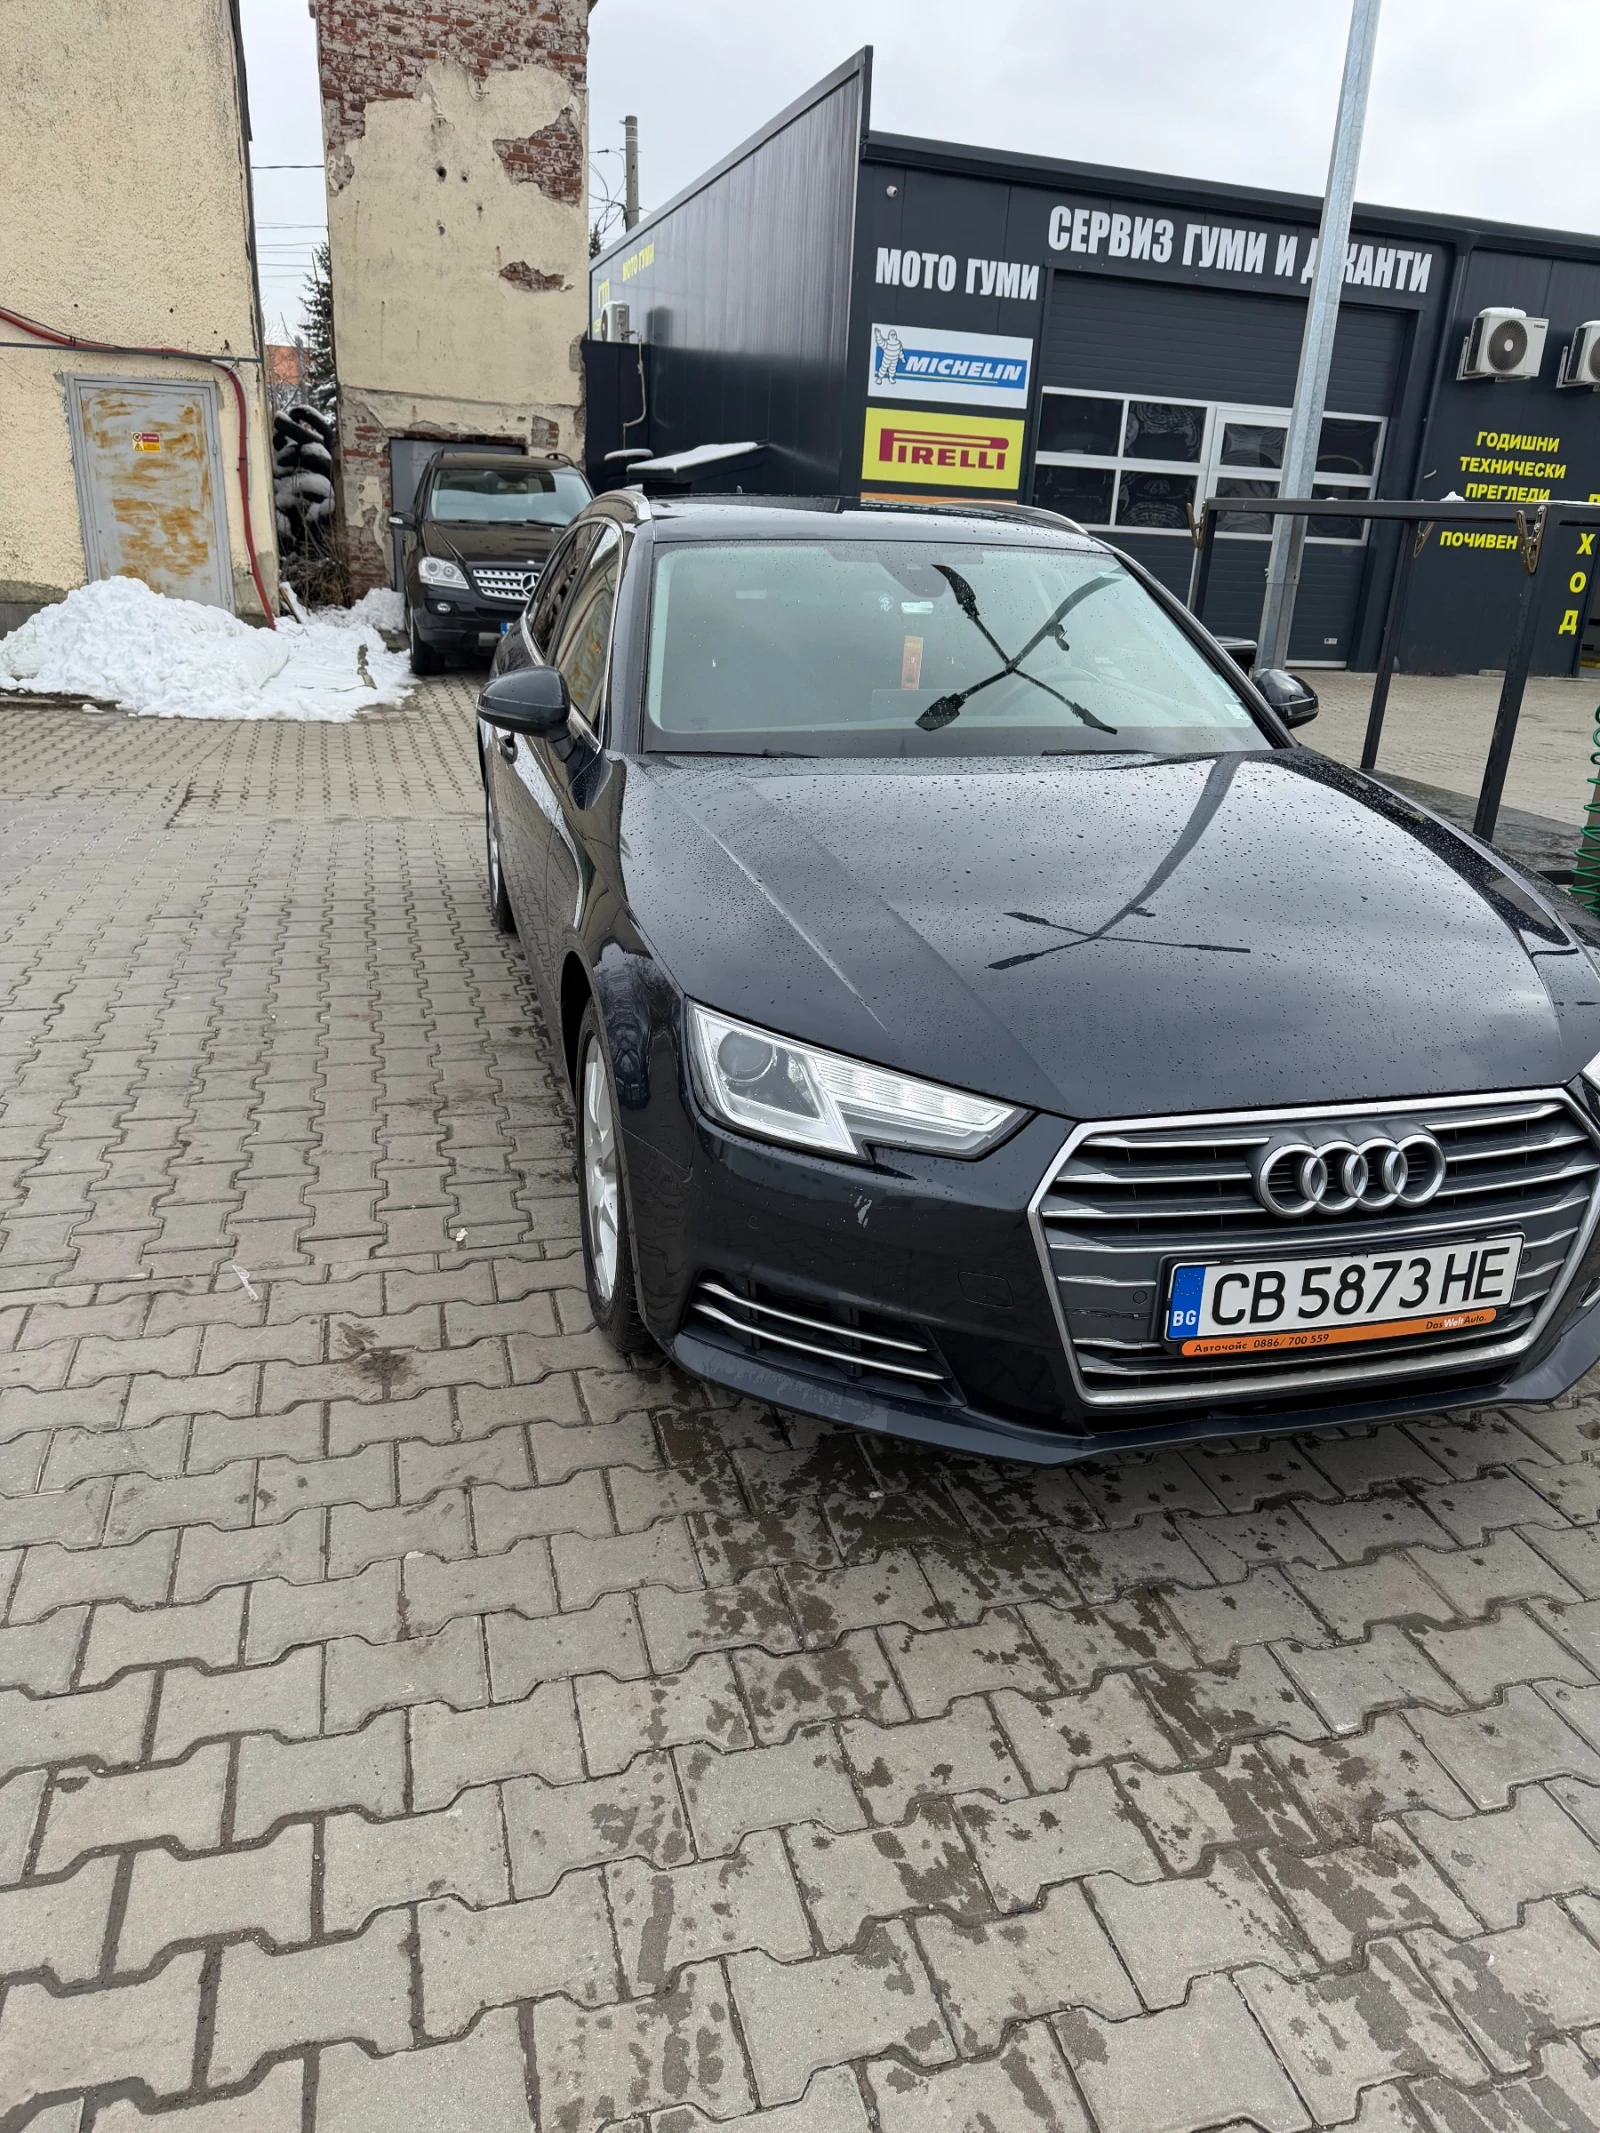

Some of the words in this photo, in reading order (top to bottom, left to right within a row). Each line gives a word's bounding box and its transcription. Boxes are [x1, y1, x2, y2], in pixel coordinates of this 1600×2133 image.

[1048, 205, 1174, 263] СЕРВИЗ
[1182, 223, 1267, 274] ГУМИ
[1274, 234, 1298, 277] И
[875, 247, 957, 292] МОТО
[965, 258, 1040, 301] ГУМИ
[904, 355, 1023, 381] MICHELIN
[878, 427, 1010, 470] PIRELLI
[1476, 431, 1560, 453] ГОДИШНИ
[1459, 456, 1567, 479] ТЕХНИЧЕСКИ
[1465, 483, 1551, 503] ПРЕГЛЕДИ
[1439, 531, 1518, 550] ПОЧИВЕН
[1211, 1270, 1286, 1326] CB
[1297, 1256, 1432, 1319] 5873
[1438, 1246, 1511, 1305] HE
[1172, 1309, 1197, 1327] BG
[1193, 1342, 1248, 1353] Авточойс
[1288, 1335, 1308, 1346] 700
[1310, 1333, 1330, 1344] 559
